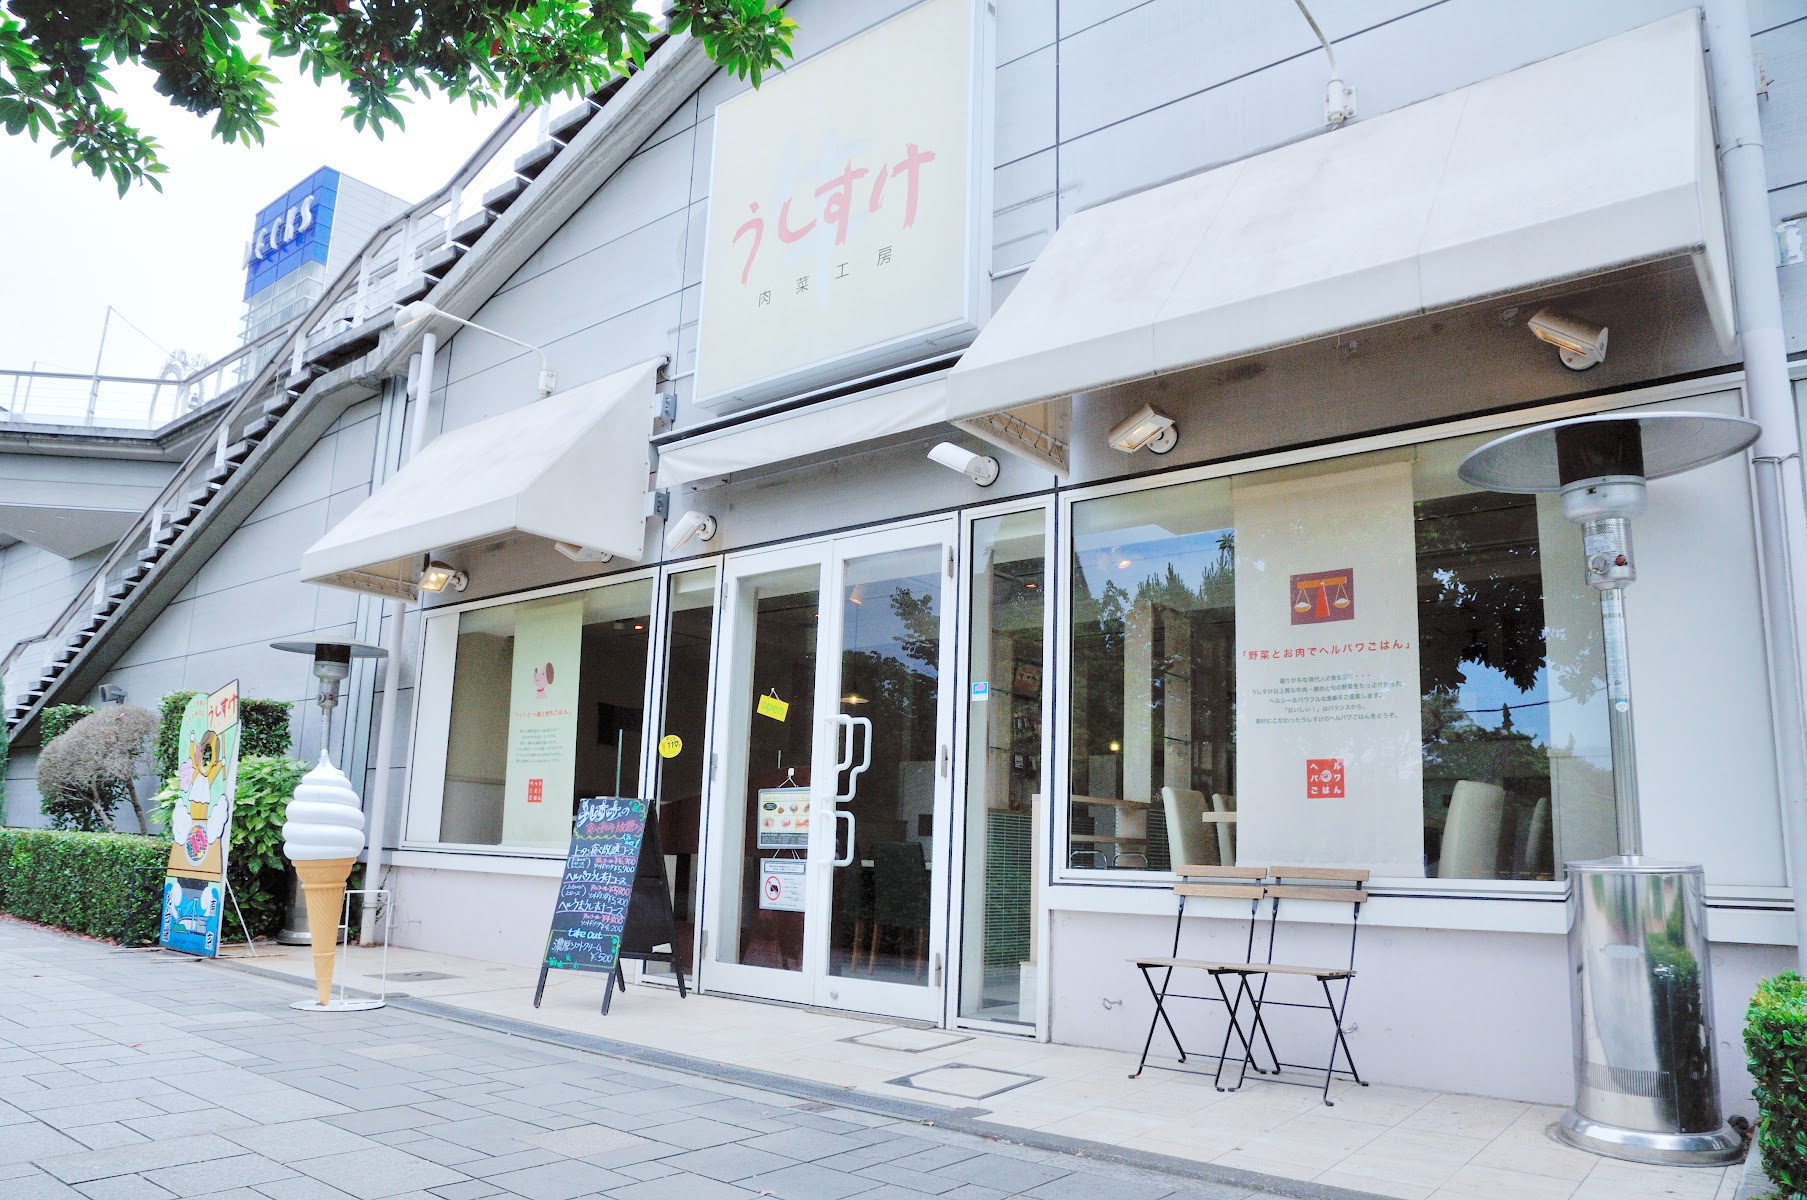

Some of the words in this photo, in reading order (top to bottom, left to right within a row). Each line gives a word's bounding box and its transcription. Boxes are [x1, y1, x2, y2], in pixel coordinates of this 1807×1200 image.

[732, 142, 936, 288] うしすけ
[758, 245, 894, 308] 肉菜工房
[761, 701, 784, 715] open
